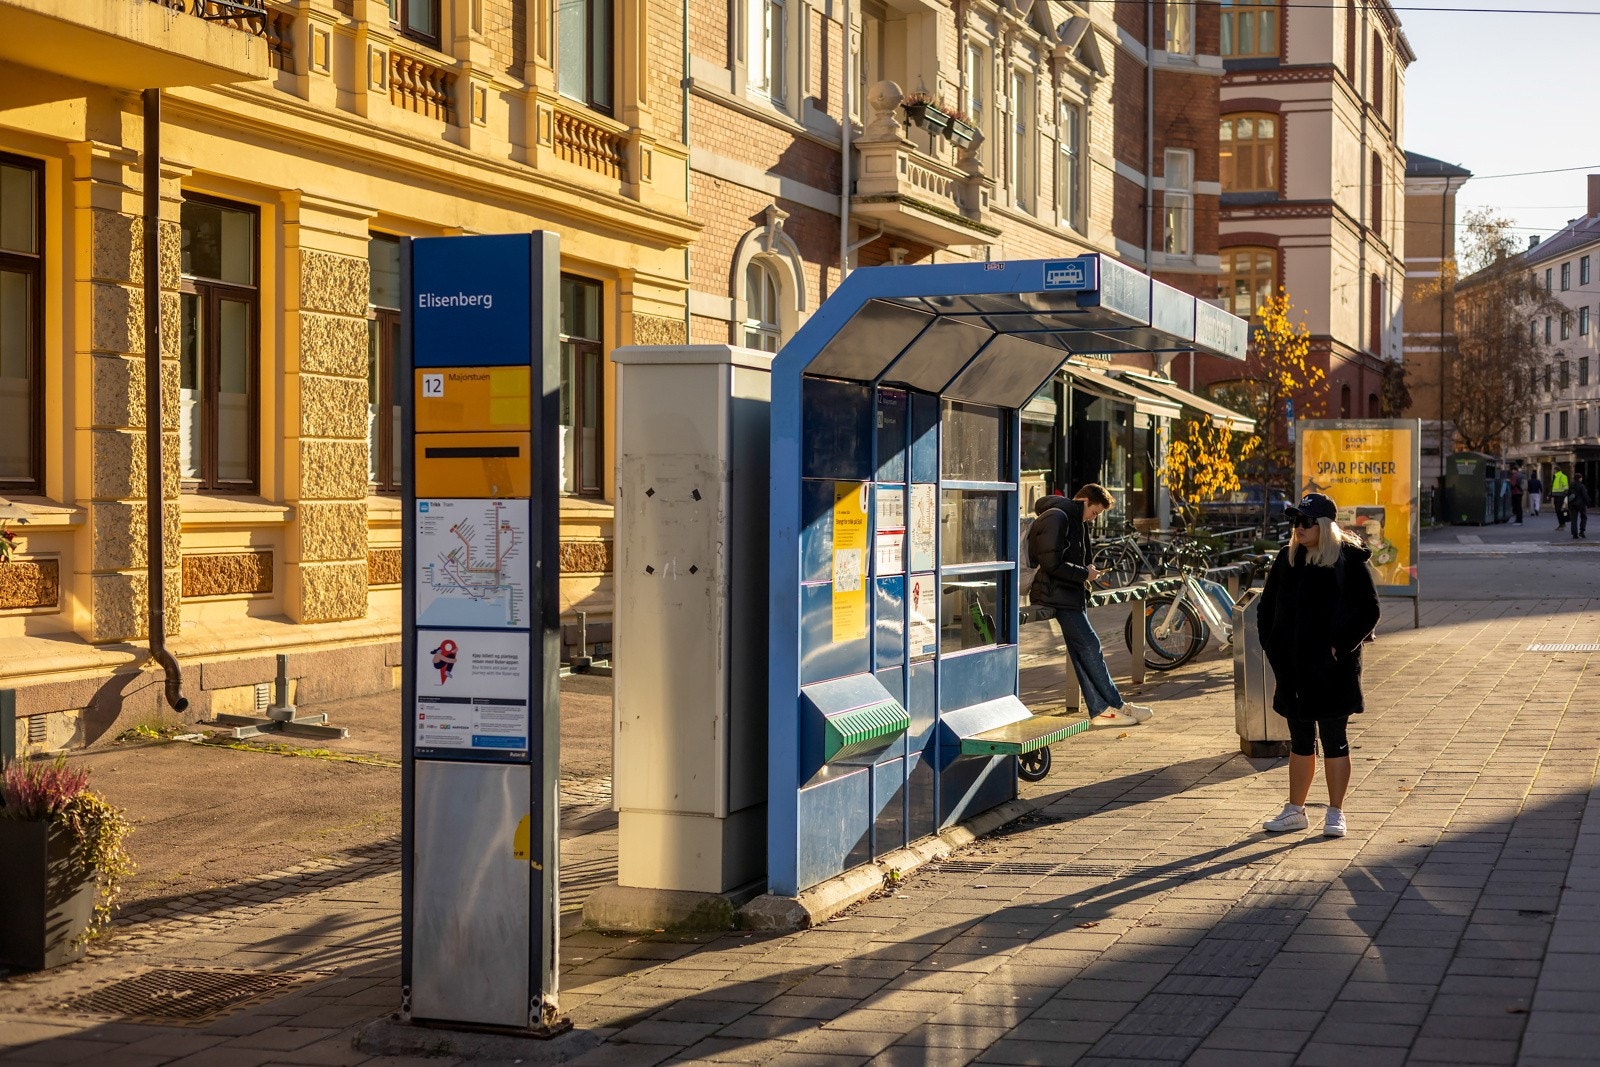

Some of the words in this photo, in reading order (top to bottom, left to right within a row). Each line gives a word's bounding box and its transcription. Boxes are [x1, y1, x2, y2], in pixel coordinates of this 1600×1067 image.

[418, 291, 493, 309] Elisenberg
[448, 372, 491, 382] Majorstuen
[424, 378, 442, 393] 12
[1317, 461, 1346, 475] SPAR
[1350, 461, 1396, 475] PENGER
